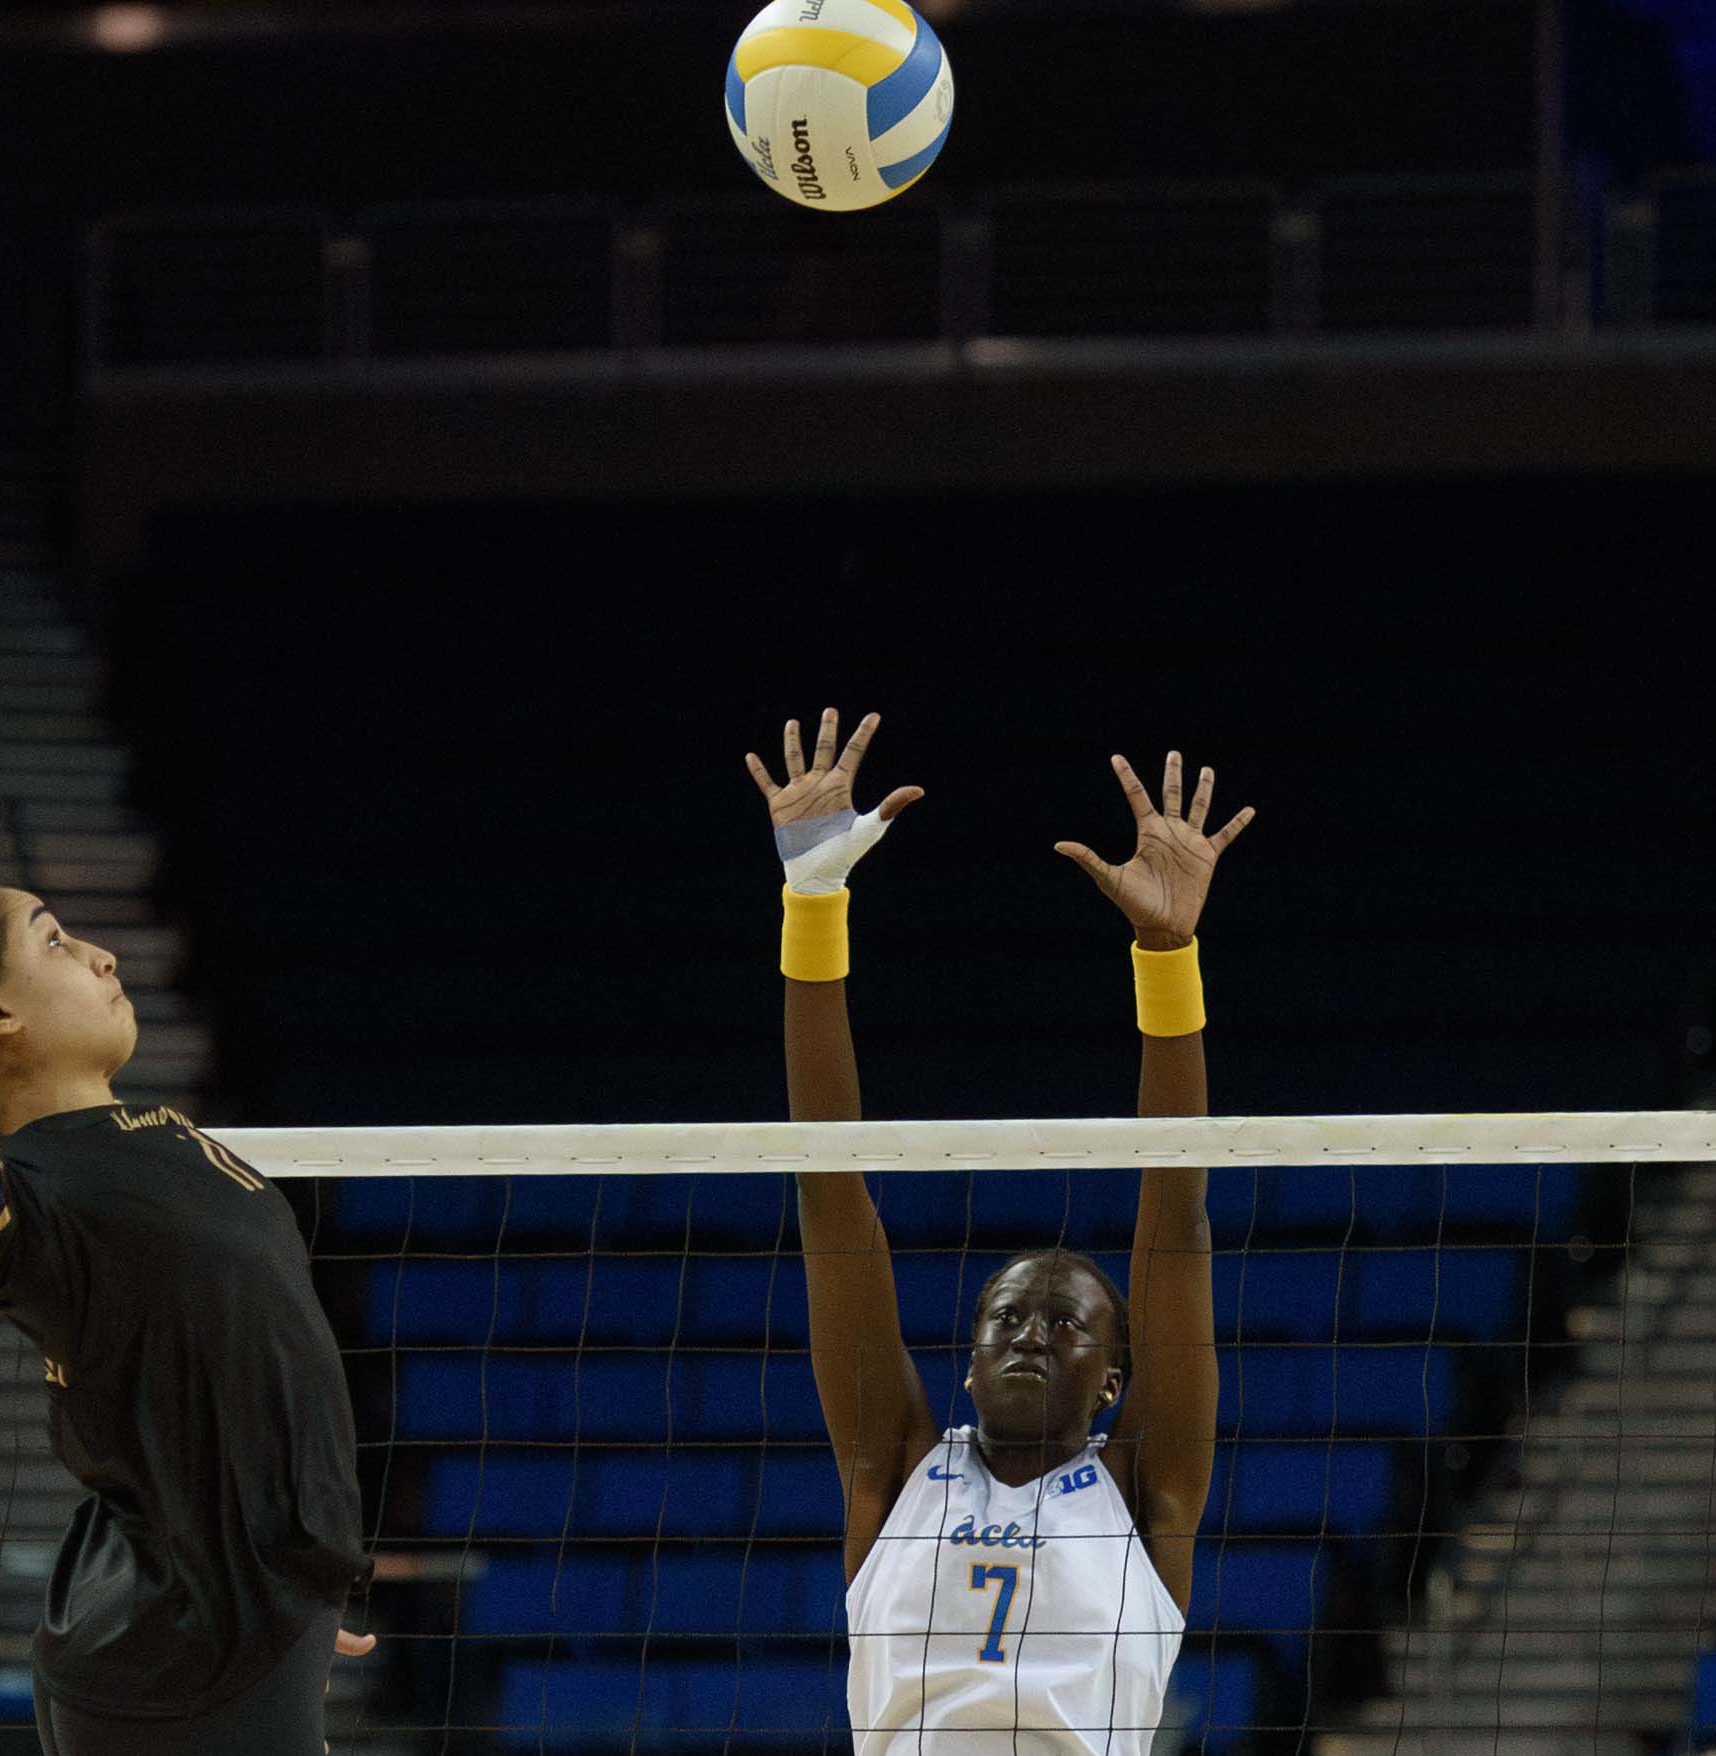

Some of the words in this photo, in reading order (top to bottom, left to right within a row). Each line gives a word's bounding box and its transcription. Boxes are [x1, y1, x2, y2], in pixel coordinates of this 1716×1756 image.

[799, 0, 825, 22] Ucl
[791, 118, 826, 200] Wilson
[845, 146, 860, 181] NOVA
[968, 1561, 1021, 1664] 7
